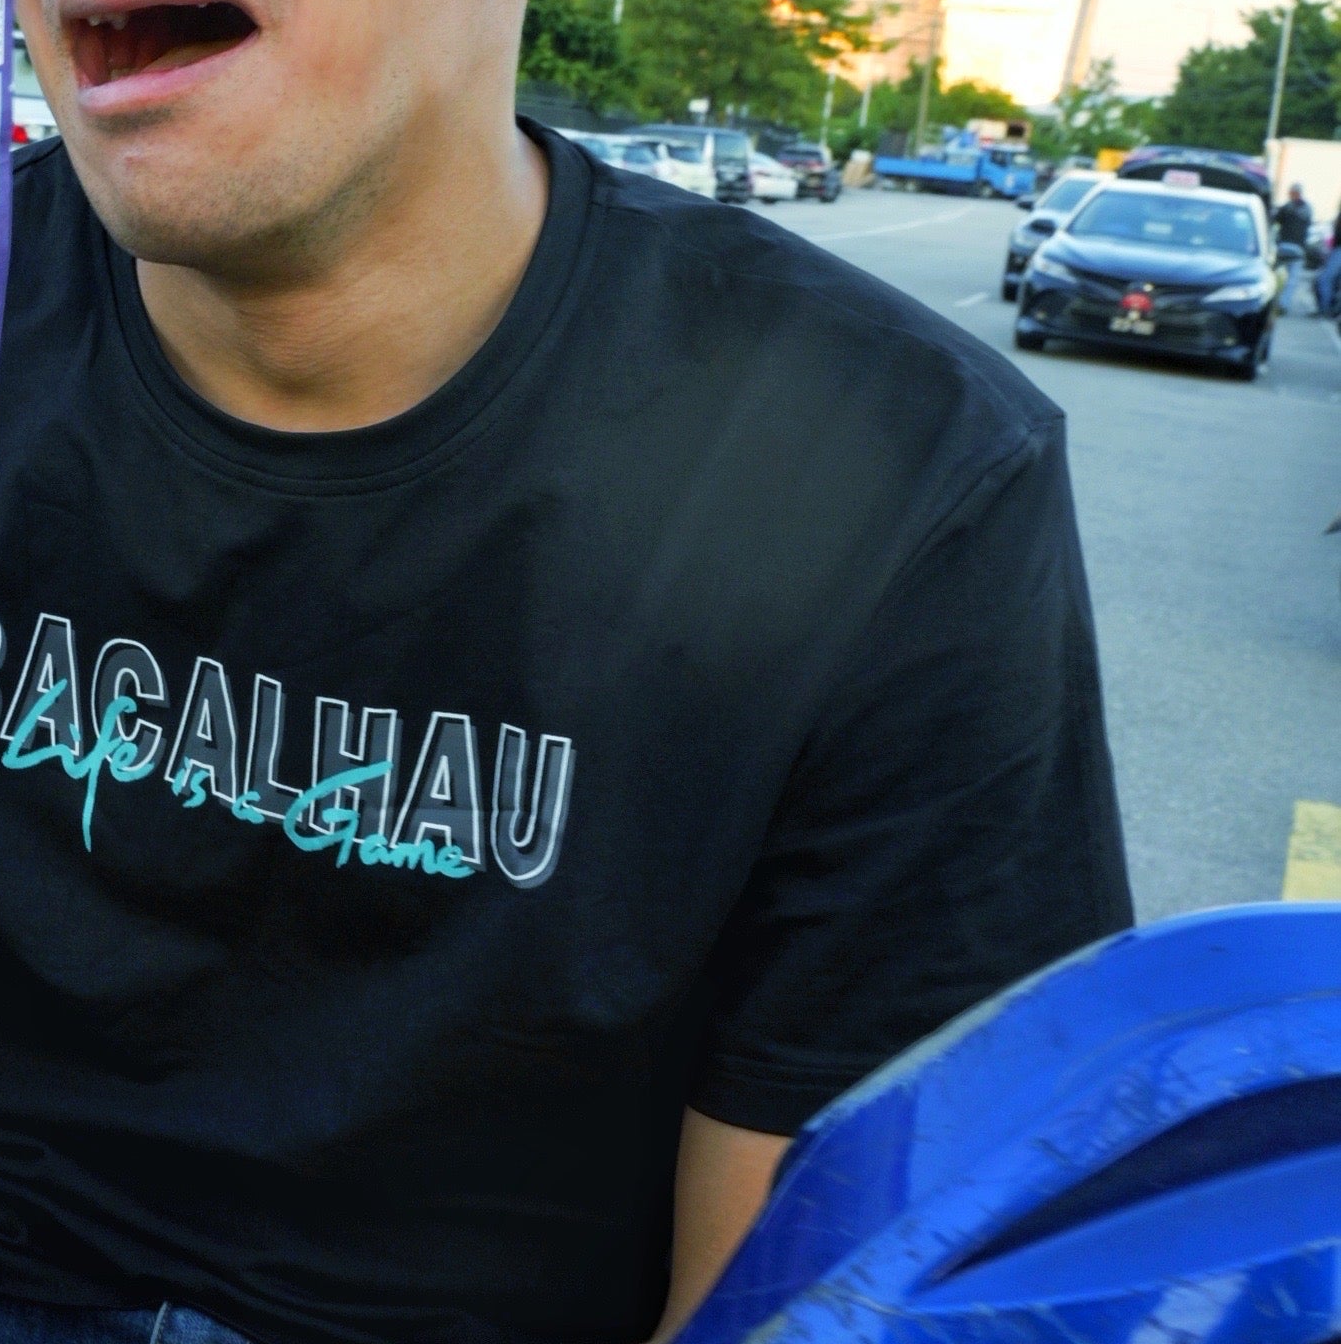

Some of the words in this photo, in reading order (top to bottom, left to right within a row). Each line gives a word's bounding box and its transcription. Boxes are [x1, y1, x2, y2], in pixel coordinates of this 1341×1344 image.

[1, 679, 155, 852] Life
[171, 757, 207, 808] is
[231, 790, 265, 825] a
[283, 760, 477, 879] Game
